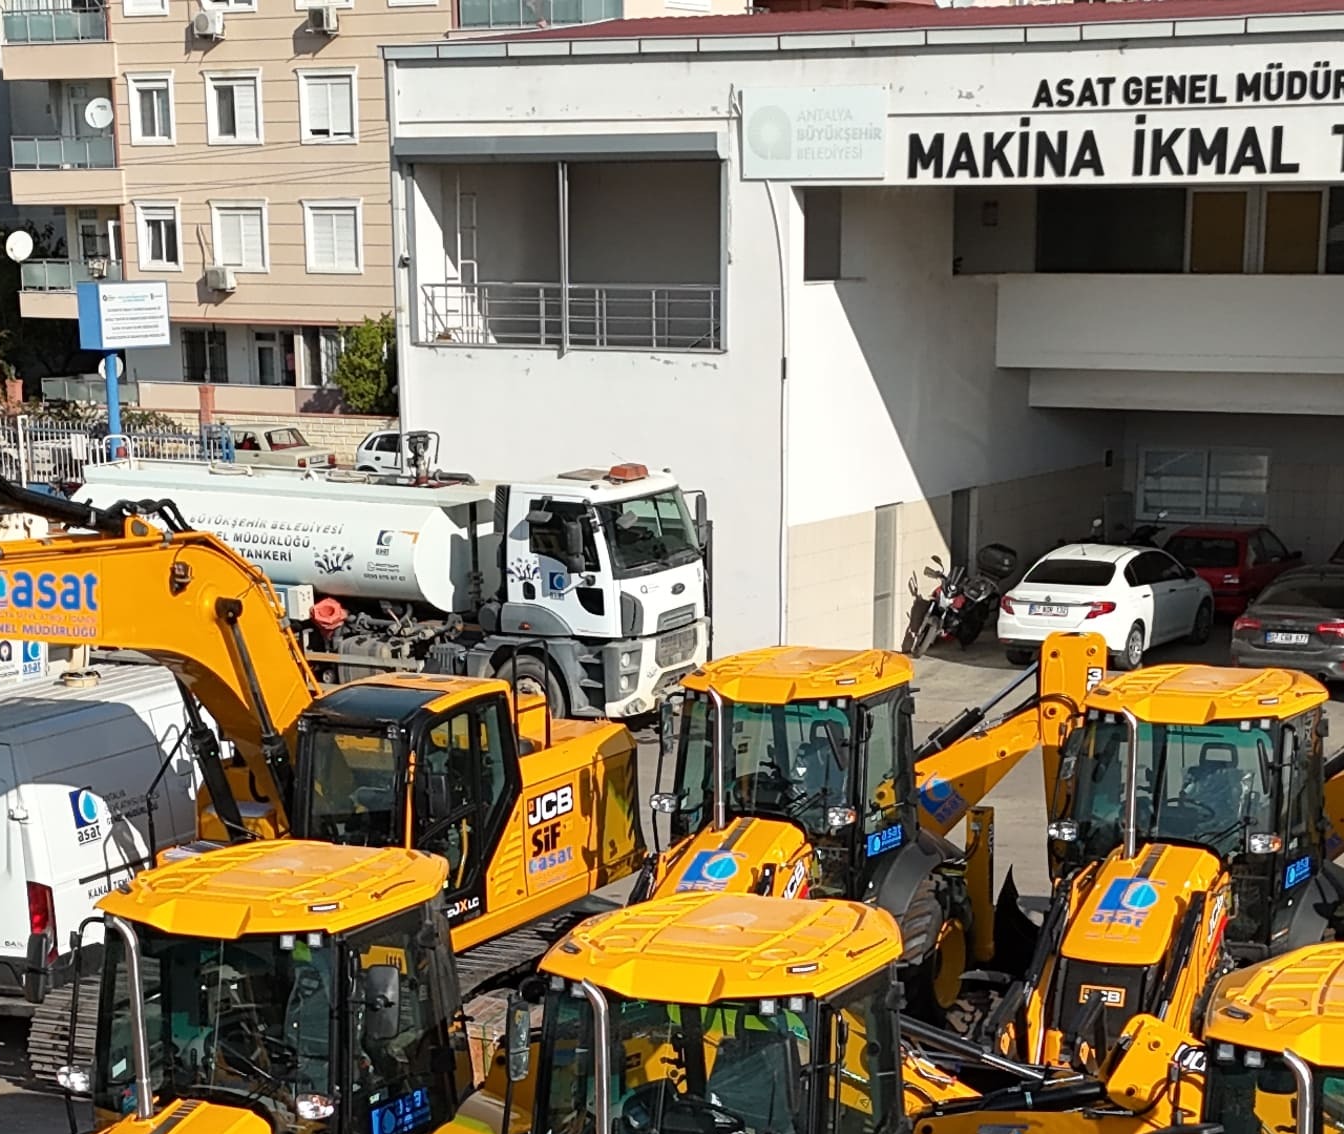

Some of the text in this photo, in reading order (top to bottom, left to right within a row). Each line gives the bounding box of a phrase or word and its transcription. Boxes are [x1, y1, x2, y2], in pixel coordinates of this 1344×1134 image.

[1032, 77, 1116, 108] ASAT
[1123, 73, 1227, 106] GENEL
[796, 108, 853, 122] ANTALYA
[796, 121, 882, 143] BÜYÜKŞEHİR
[796, 144, 864, 161] BELEDİYESİ
[907, 117, 1105, 180] MAKİNA
[1132, 114, 1300, 177] İKMAL
[232, 532, 311, 549] MÜDÜRLÜĞÜ
[239, 547, 292, 562] TANKERİ
[11, 571, 98, 611] asat
[529, 786, 573, 825] JCB
[538, 846, 573, 871] asat
[88, 884, 109, 899] KANA
[1091, 913, 1145, 929] asat
